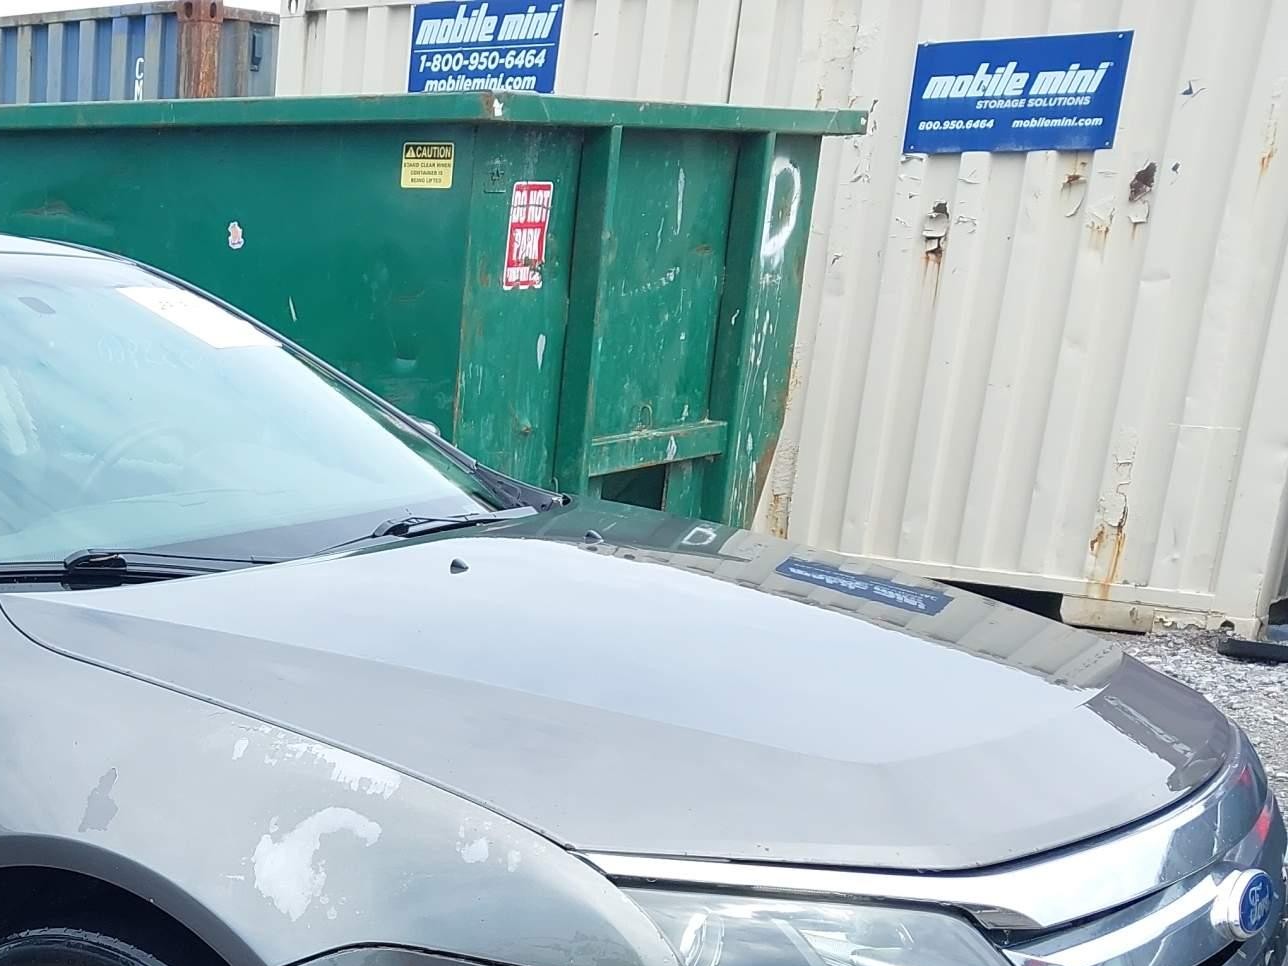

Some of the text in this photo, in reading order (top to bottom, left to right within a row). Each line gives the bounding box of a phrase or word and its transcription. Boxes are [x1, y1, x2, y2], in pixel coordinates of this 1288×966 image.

[415, 3, 559, 45] mobile mini
[419, 49, 546, 72] 1-800-950-6464
[424, 73, 536, 92] mobilemini.com
[922, 61, 1112, 99] mobile mini
[975, 96, 1091, 109] STORAGE SOLUTIONS
[918, 117, 1103, 131] 800.950.6464 mobilemini.com
[415, 146, 452, 158] CAUTION
[512, 189, 551, 223] DO NOT
[512, 227, 542, 262] PARK
